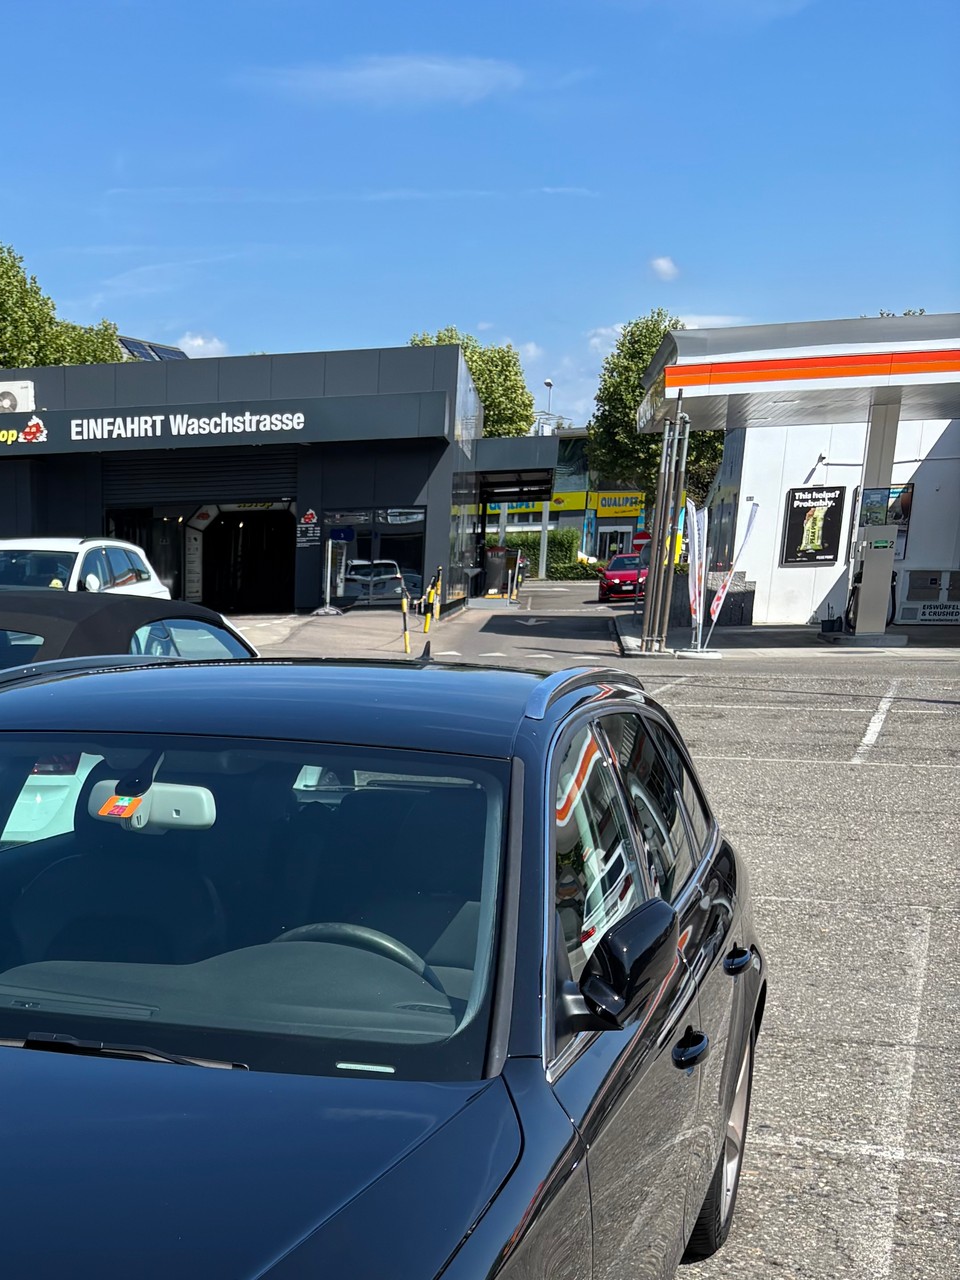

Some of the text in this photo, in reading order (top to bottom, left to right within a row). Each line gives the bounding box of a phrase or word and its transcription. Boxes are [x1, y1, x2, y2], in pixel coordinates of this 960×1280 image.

[70, 411, 305, 441] EINFAHRT Waschstrasse
[794, 490, 840, 500] This helps?
[793, 499, 836, 508] Probably.
[869, 540, 895, 549] 1 2
